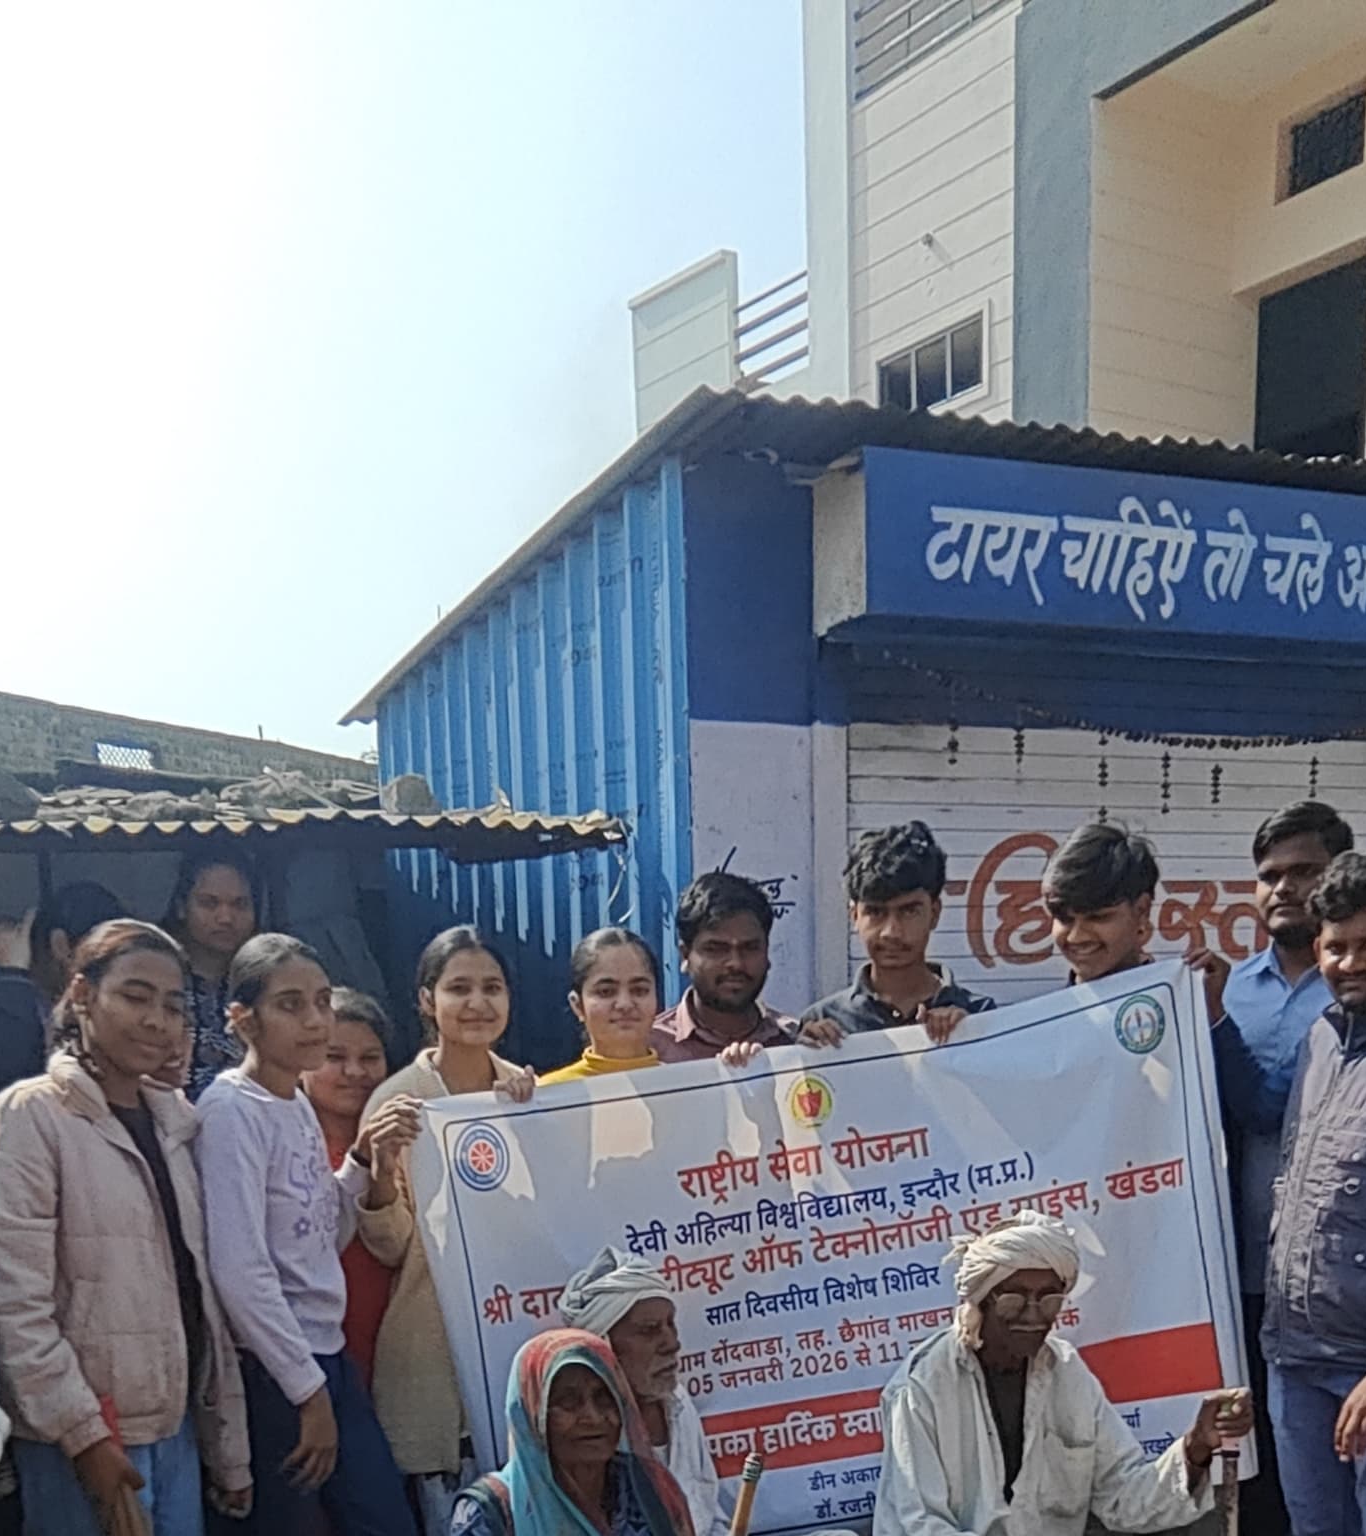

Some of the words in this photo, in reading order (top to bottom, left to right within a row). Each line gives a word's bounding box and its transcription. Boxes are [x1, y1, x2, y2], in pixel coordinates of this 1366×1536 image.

[926, 506, 1059, 606] टायर
[1203, 507, 1258, 602] तो
[1263, 512, 1333, 613] चले
[677, 1149, 759, 1205] राष्ट्रीय
[767, 1139, 823, 1182] सेवा
[830, 1126, 930, 1170] योजना
[625, 1219, 668, 1257] देवी
[673, 1210, 752, 1247] अहिल्या
[899, 1167, 962, 1208] इन्दौर
[966, 1150, 1036, 1195] (म.प्र.)
[482, 1283, 514, 1325] श्री
[741, 1232, 804, 1275] ऑफ
[809, 1204, 953, 1264] टेक्नोलॉजी
[958, 1197, 1002, 1237] एंड
[1104, 1157, 1184, 1200] खंडवा
[705, 1299, 742, 1327] सात
[744, 1283, 820, 1320] दिवसीय
[822, 1272, 878, 1310] विशेष
[881, 1262, 941, 1296] शिविर
[796, 1328, 833, 1351] तह.
[895, 1306, 955, 1333] माखन
[687, 1373, 714, 1398] 05
[718, 1356, 784, 1389] जनवरी
[791, 1350, 849, 1380] 2026
[853, 1341, 872, 1367] से
[877, 1341, 905, 1364] 11
[704, 1427, 756, 1459] पका
[759, 1409, 837, 1455] हार्दिक
[807, 1469, 837, 1492] डीन
[813, 1497, 837, 1519] डॉ.
